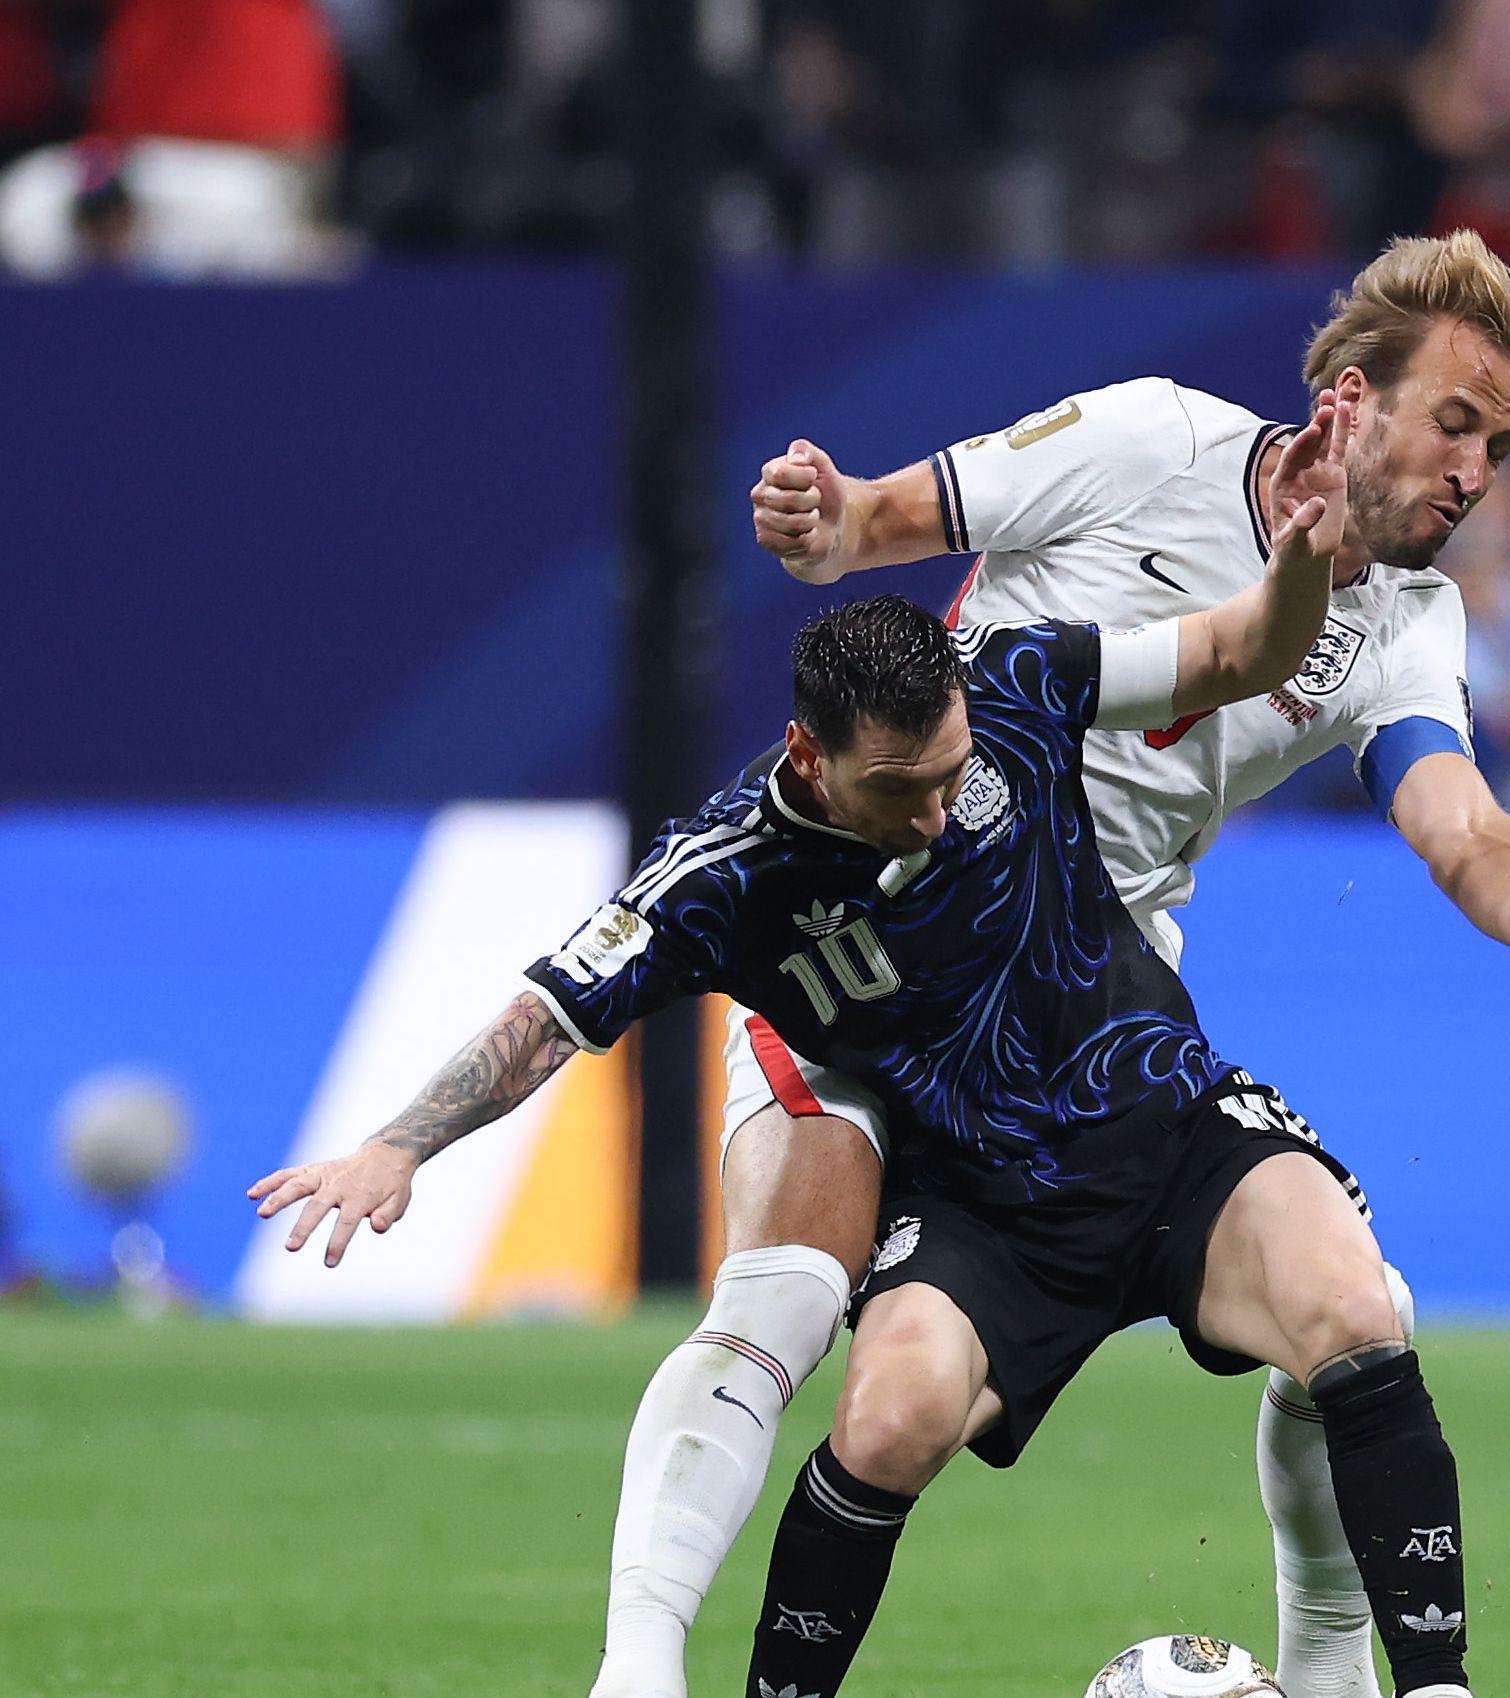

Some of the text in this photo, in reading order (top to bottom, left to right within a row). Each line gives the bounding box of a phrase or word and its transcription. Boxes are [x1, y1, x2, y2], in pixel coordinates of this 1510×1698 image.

[960, 778, 994, 814] AFA
[778, 916, 902, 1027] 10
[1400, 1525, 1457, 1562] AFA
[771, 1602, 842, 1643] AFA
